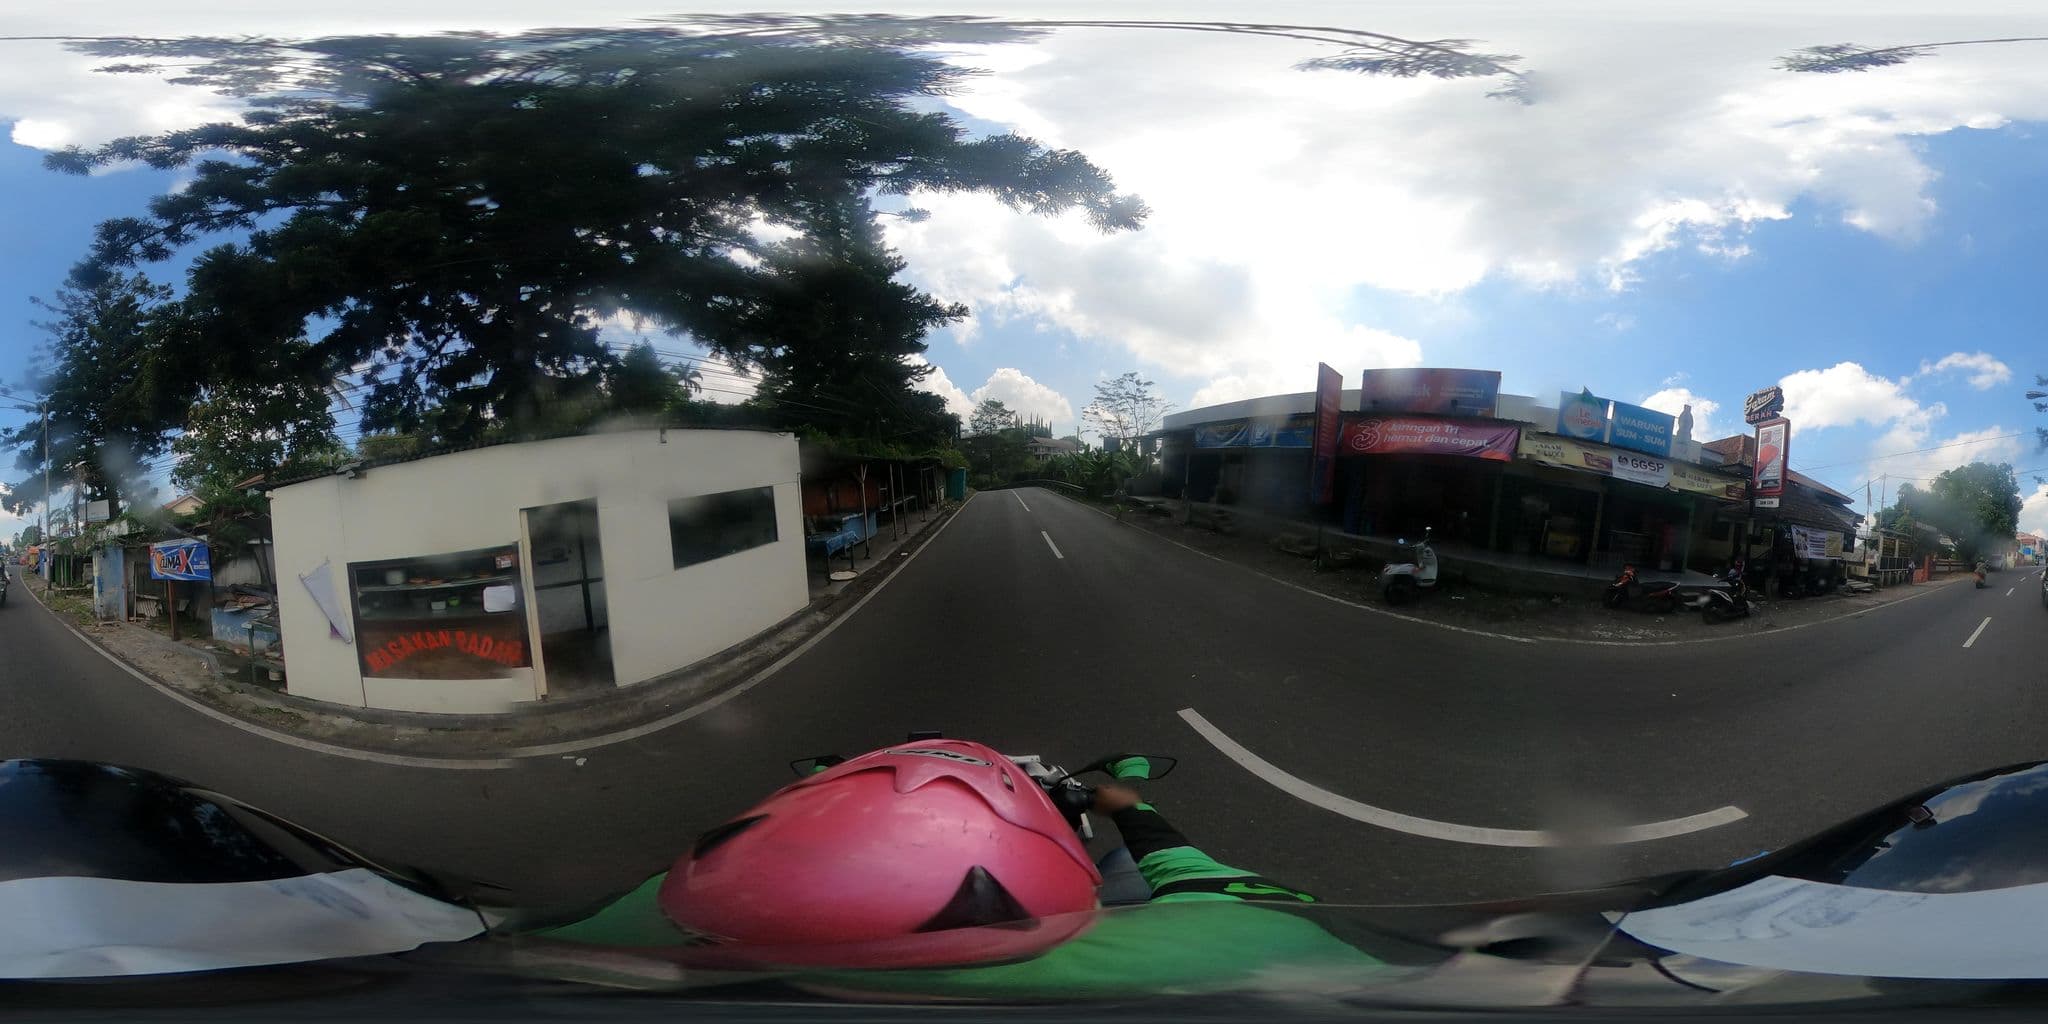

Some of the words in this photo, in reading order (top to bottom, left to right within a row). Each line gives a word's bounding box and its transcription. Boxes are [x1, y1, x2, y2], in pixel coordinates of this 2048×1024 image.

[1444, 423, 1459, 434] Tri
[1620, 415, 1665, 434] WARUNG
[1384, 433, 1424, 442] hemat
[1425, 433, 1448, 443] dan
[1616, 428, 1637, 441] SUM
[1643, 434, 1666, 447] SUM
[1631, 458, 1665, 473] GGSP
[364, 630, 452, 673] MASAKAN
